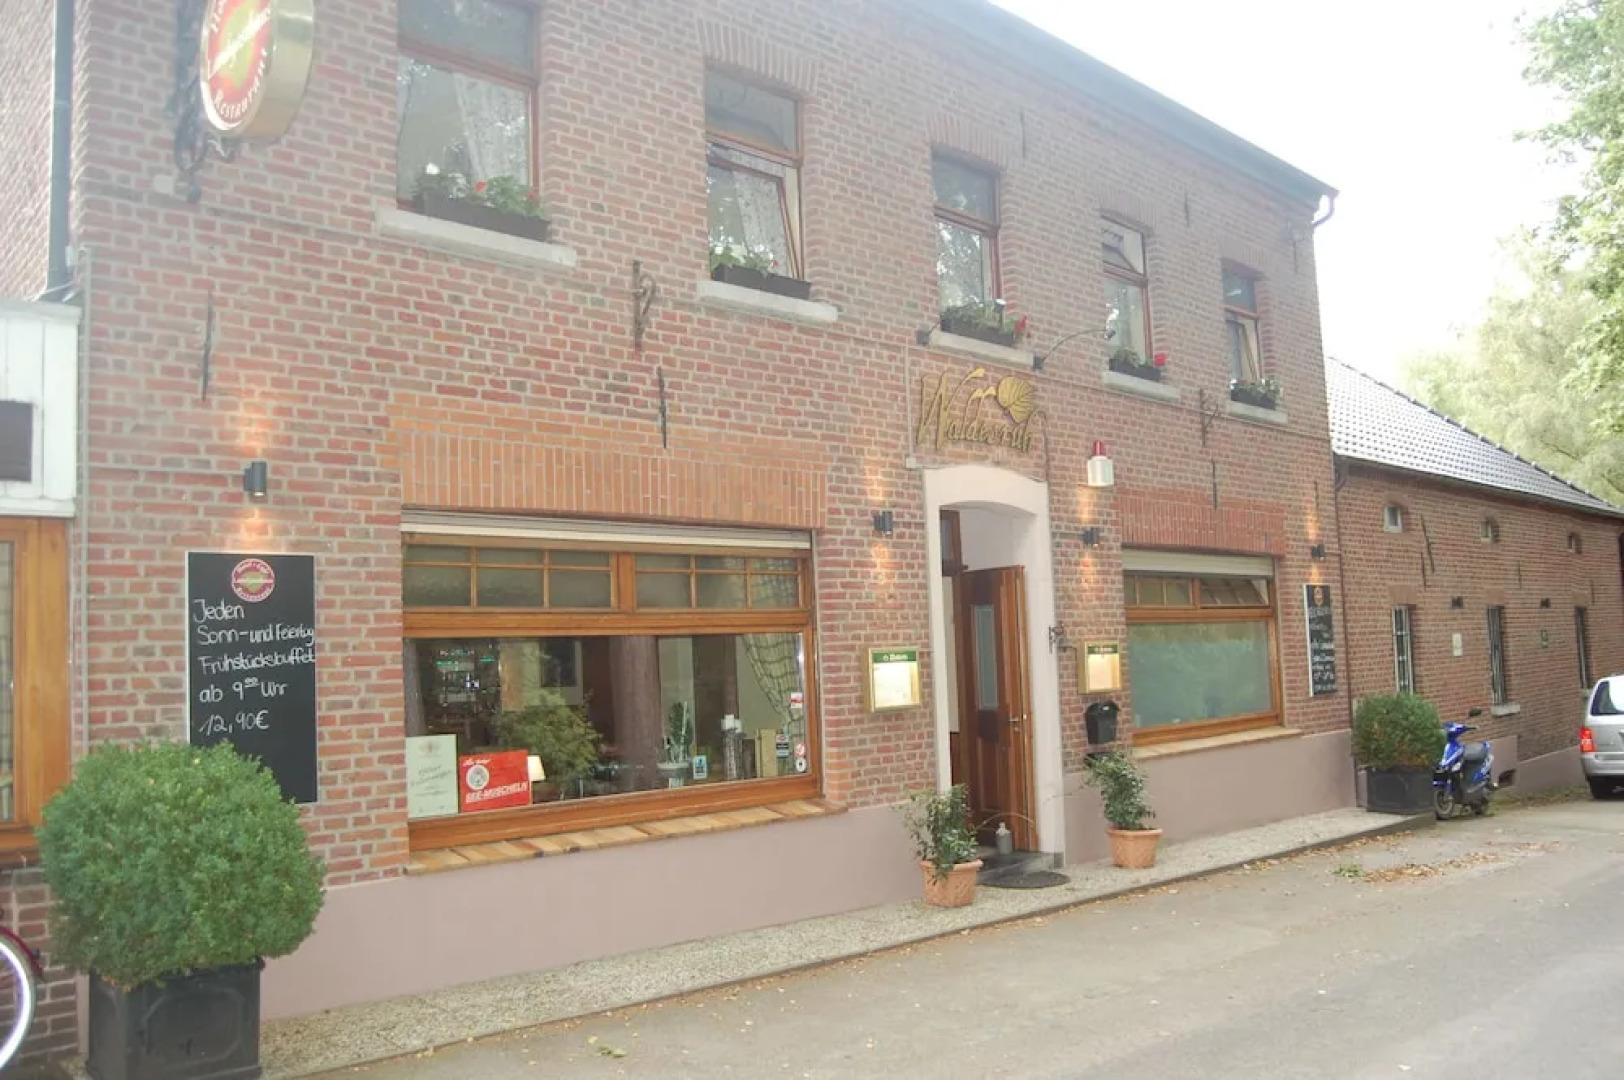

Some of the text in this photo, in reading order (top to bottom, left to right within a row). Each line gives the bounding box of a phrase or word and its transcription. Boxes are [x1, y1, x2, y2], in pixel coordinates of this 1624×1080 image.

[193, 599, 244, 622] Jeden
[199, 684, 223, 703] ab
[261, 681, 289, 697] Uhr
